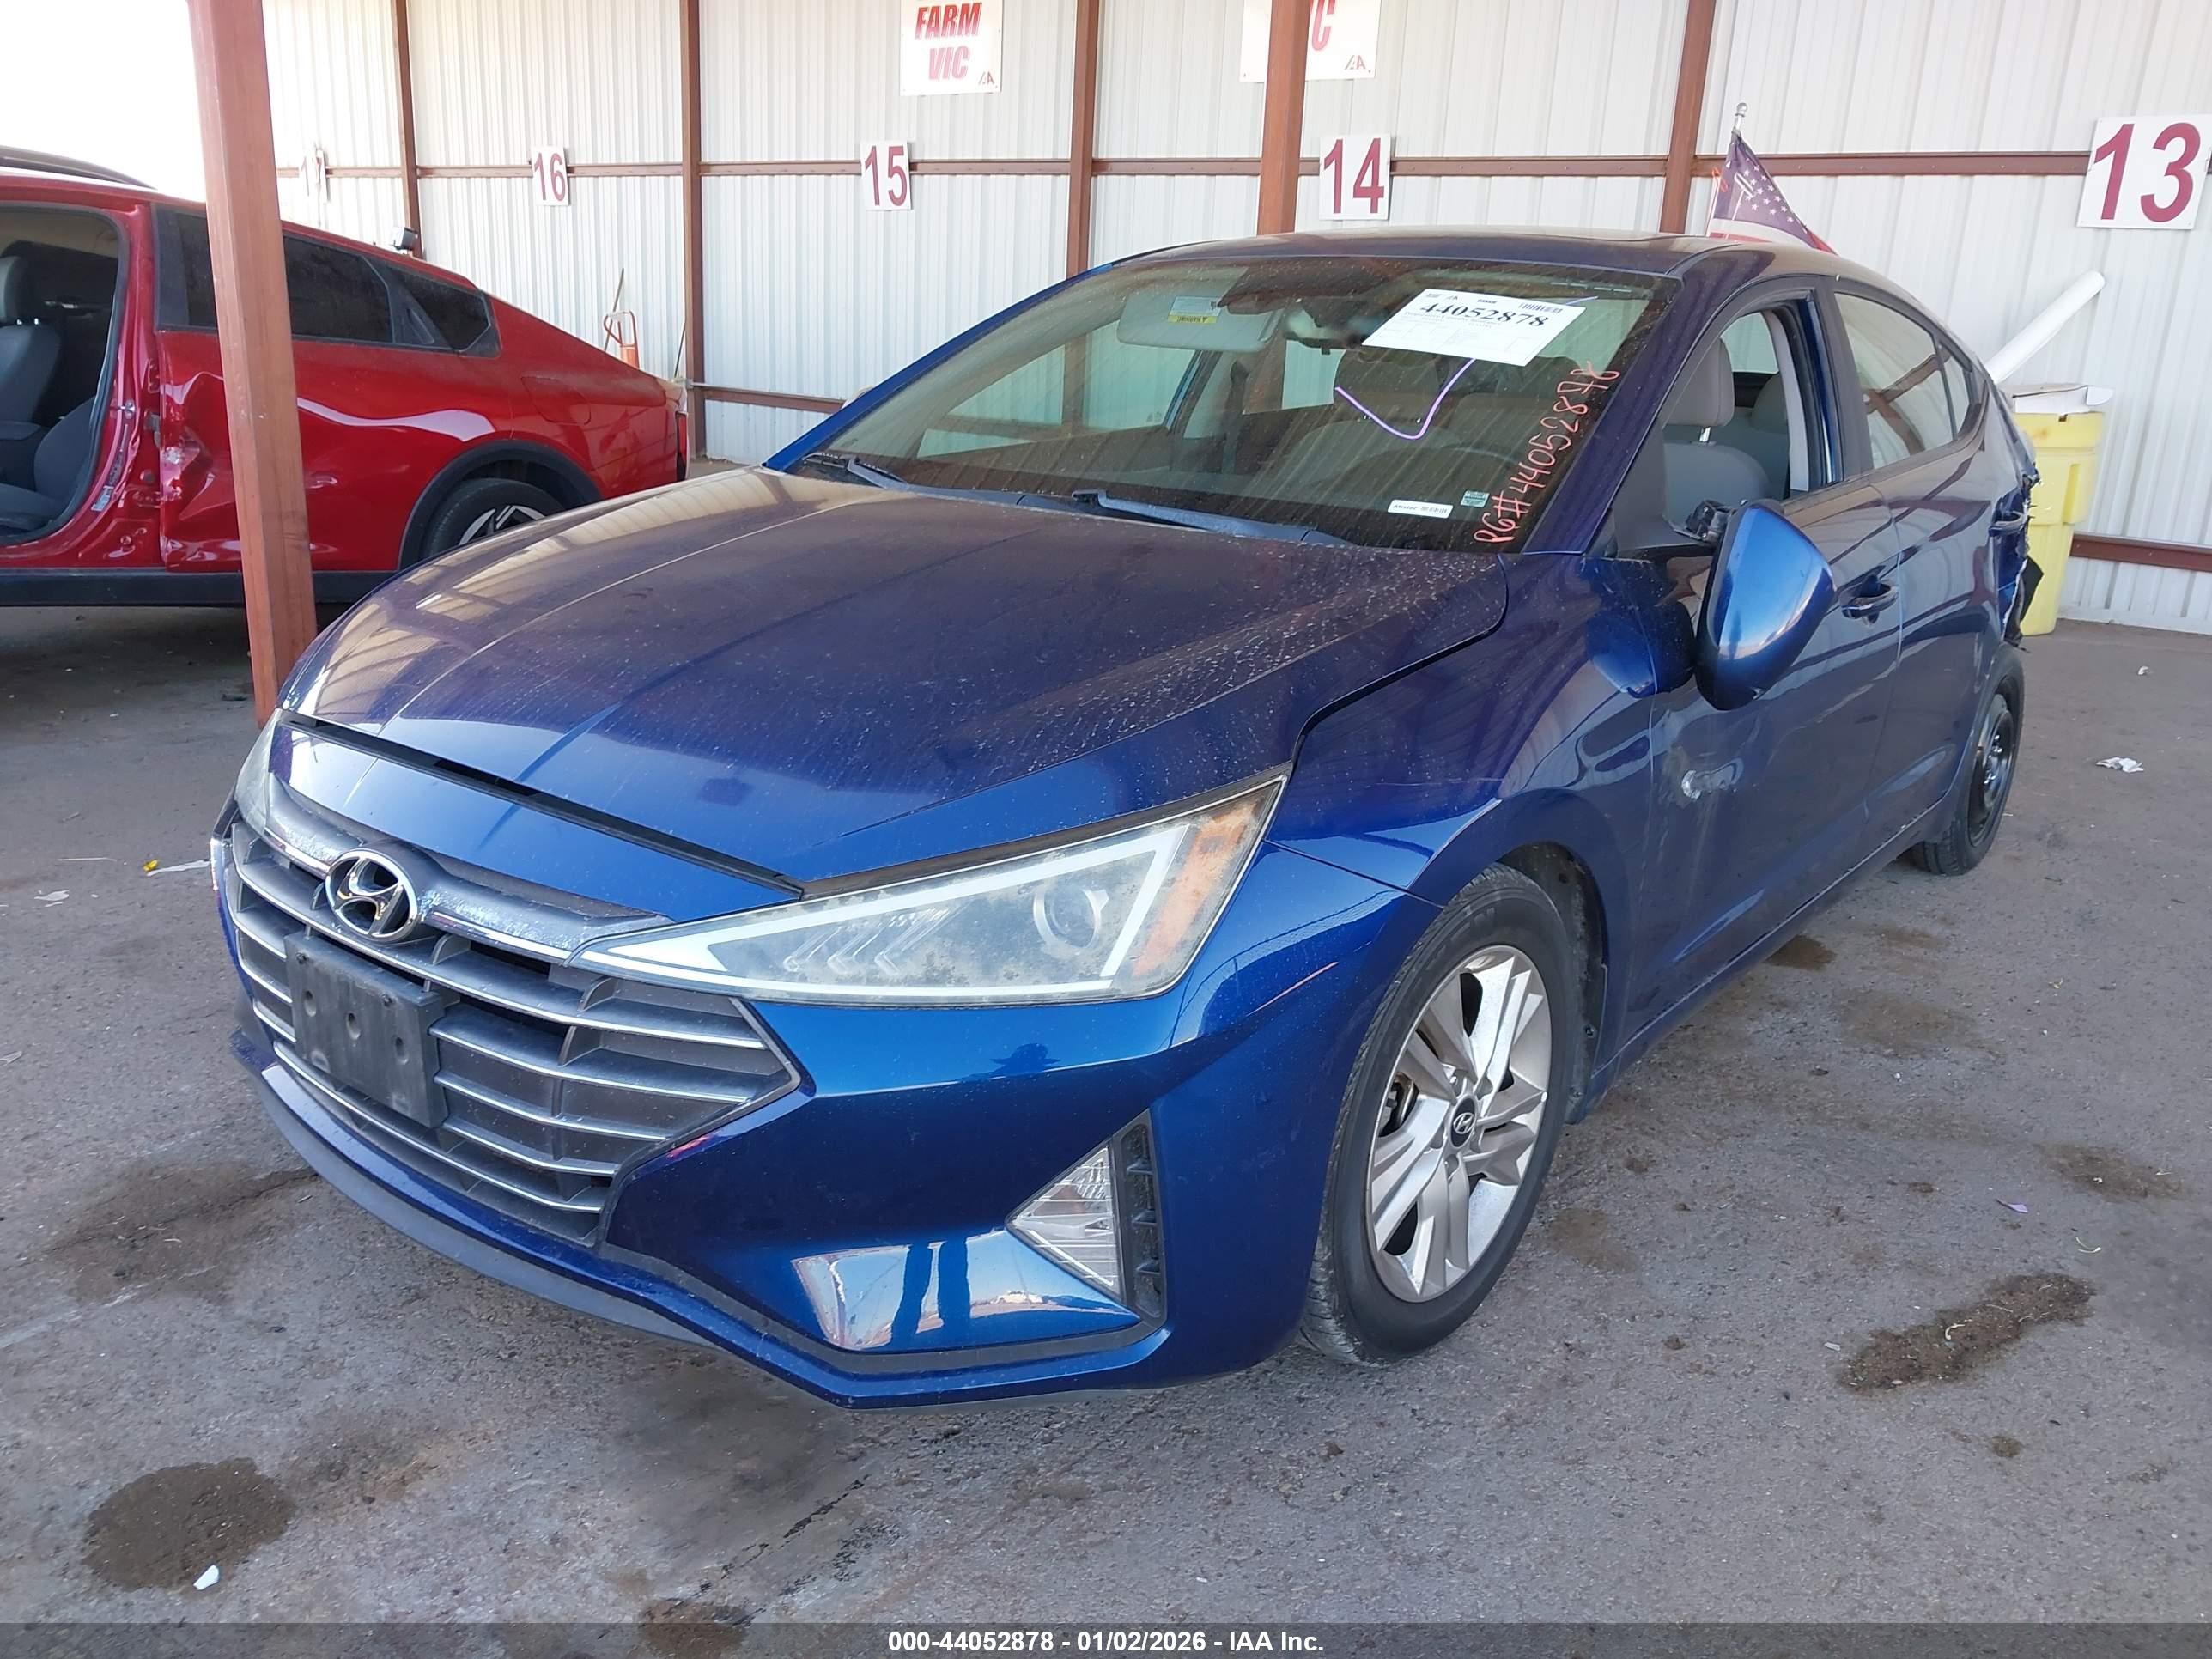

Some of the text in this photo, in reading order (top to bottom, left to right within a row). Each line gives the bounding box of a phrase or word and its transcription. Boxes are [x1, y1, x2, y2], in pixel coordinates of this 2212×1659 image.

[915, 3, 982, 40] FARM
[928, 46, 969, 80] VIC
[534, 153, 566, 201] 16
[865, 145, 908, 206] 15
[1323, 137, 1384, 214] 14
[2094, 122, 2201, 222] 13
[1419, 302, 1549, 326] 44052878
